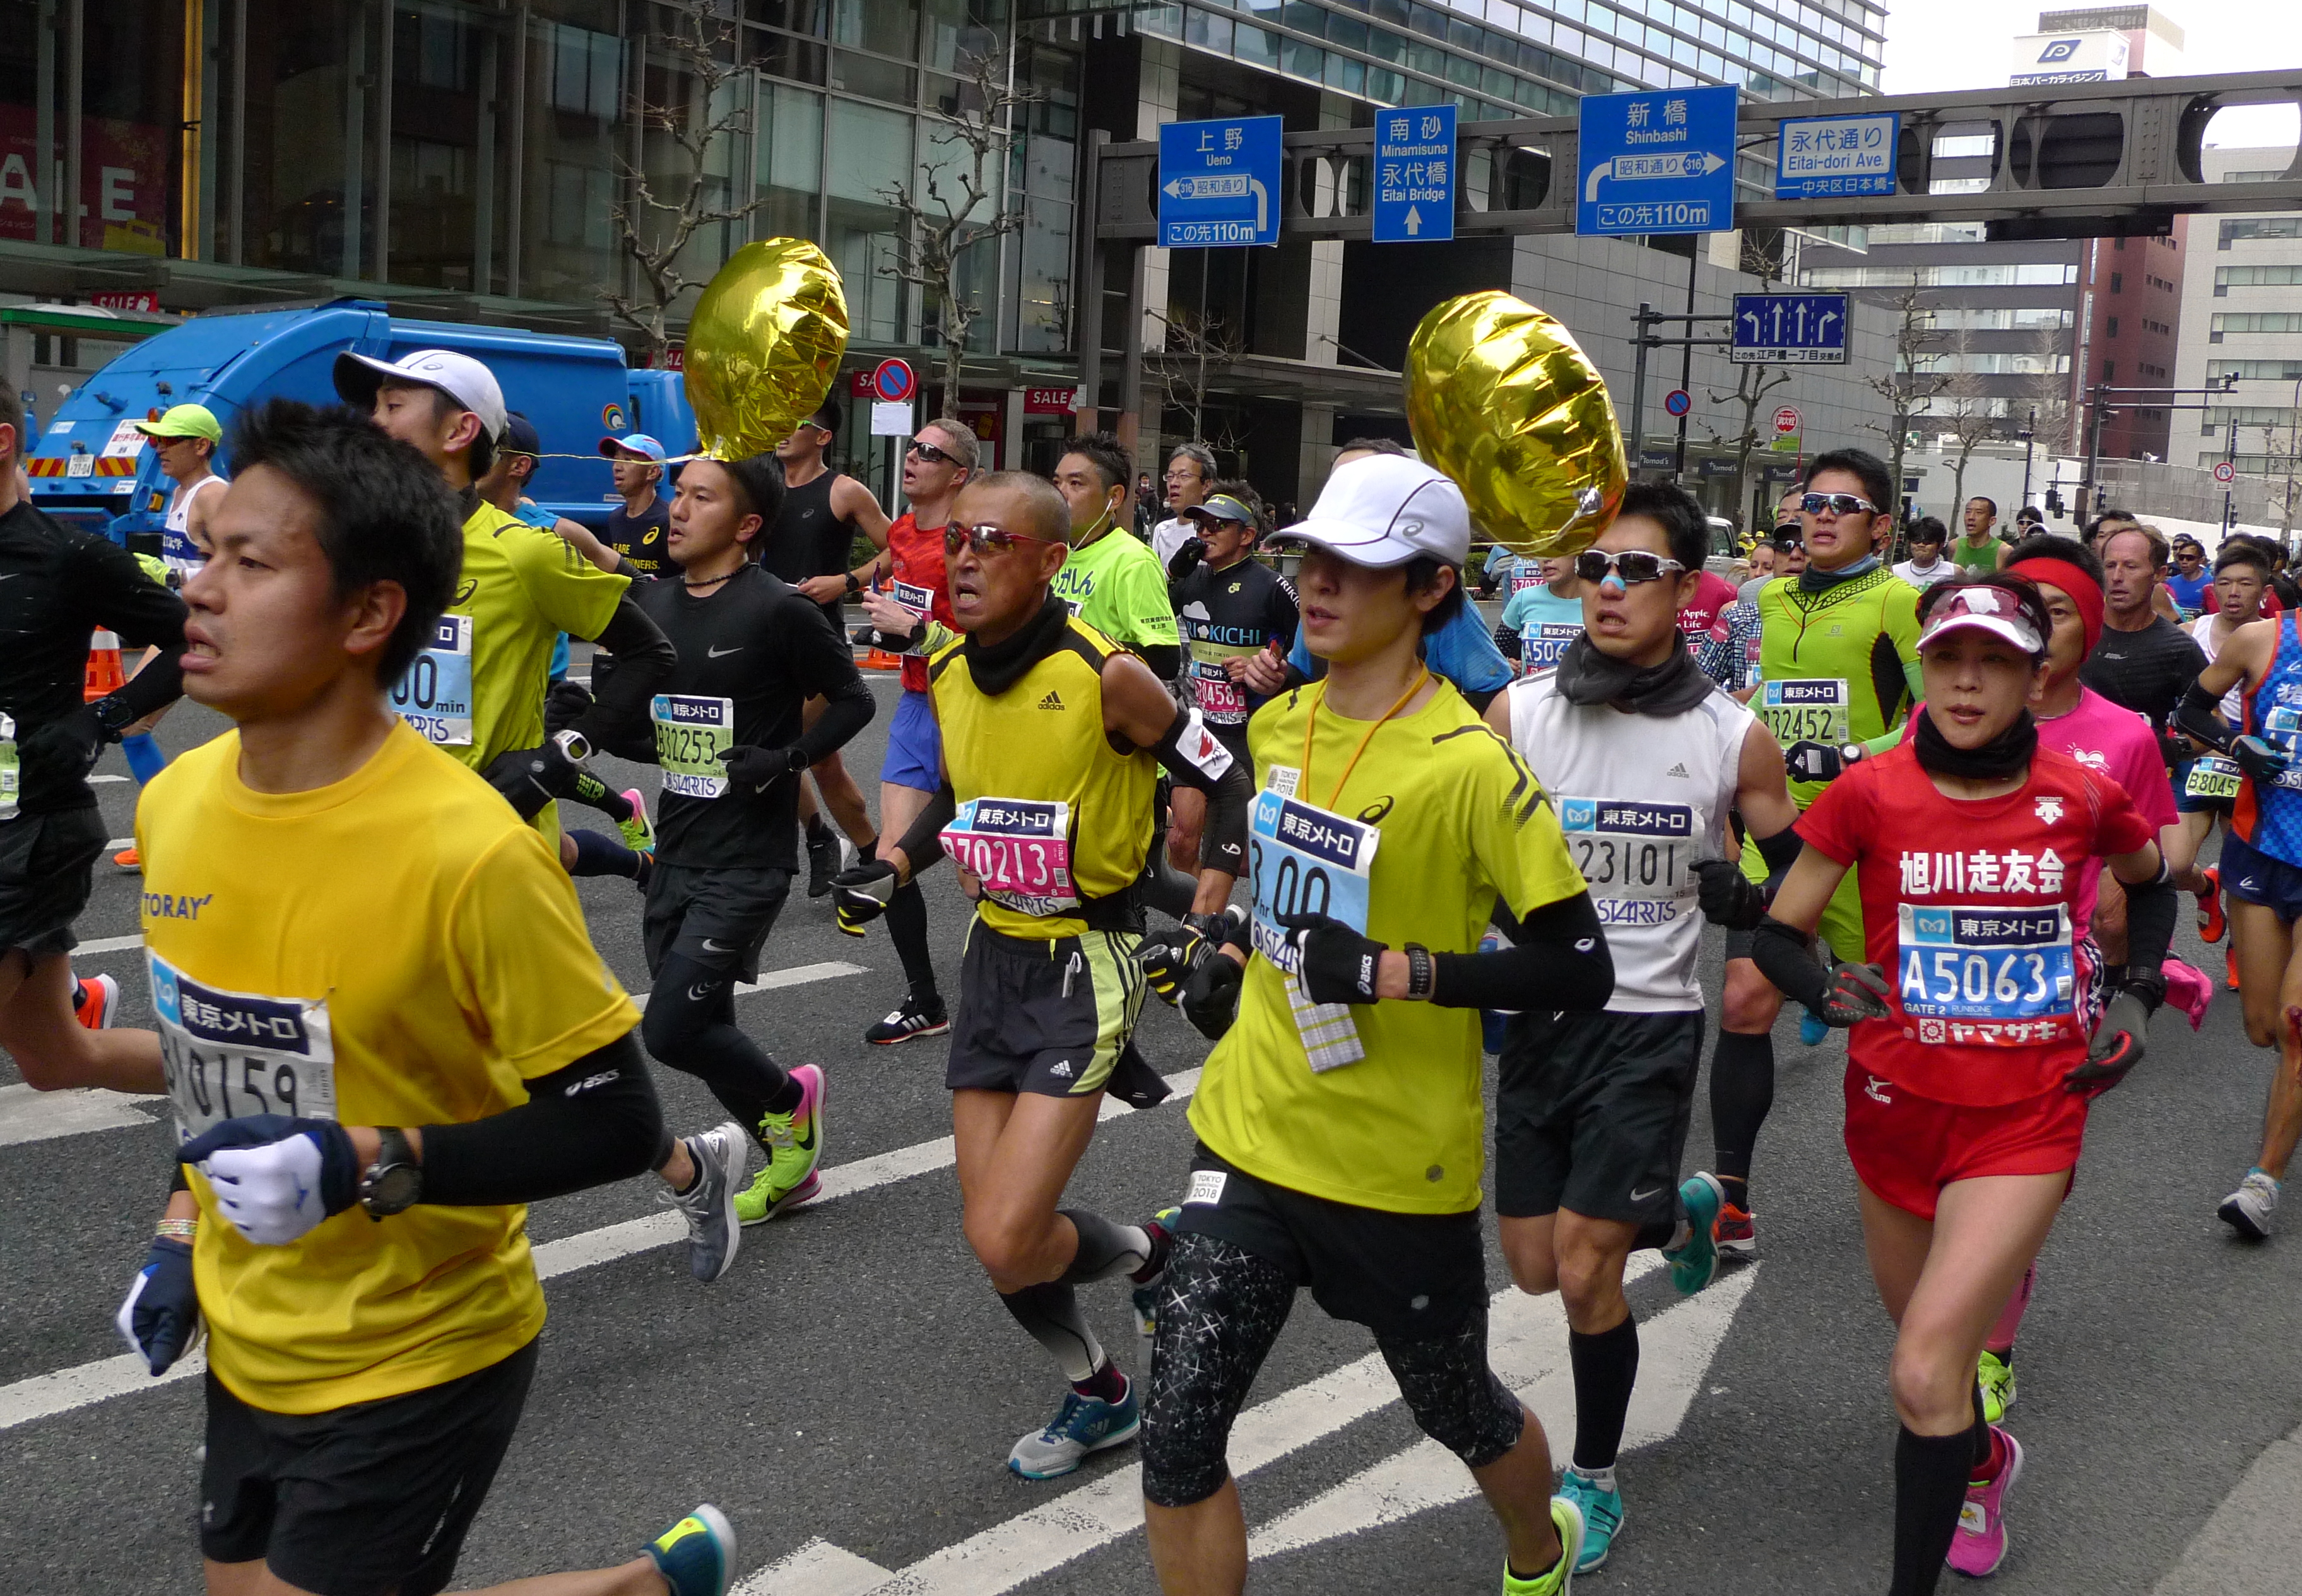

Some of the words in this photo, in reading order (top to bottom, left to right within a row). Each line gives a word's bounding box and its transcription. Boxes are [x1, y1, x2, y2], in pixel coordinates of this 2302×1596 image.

[2010, 73, 2104, 86] 日本パーカライジング
[1626, 99, 1687, 127] 新橋
[1390, 115, 1442, 141] 南砂
[1626, 127, 1687, 145] Shinbashi
[1196, 127, 1242, 151] 上野
[1791, 127, 1882, 152] 永代通り
[1381, 143, 1448, 157] Minamisuna
[1207, 154, 1232, 166] Ueno
[1620, 158, 1678, 175] 昭和通り
[1685, 159, 1702, 170] 316
[1788, 153, 1851, 170] Eitai-dori
[1856, 153, 1884, 167] Ave.
[1382, 161, 1447, 187] 永代橋
[1180, 183, 1193, 194] 316
[1198, 179, 1243, 194] 昭和通り
[1802, 177, 1887, 194] 中央区日本橋
[1382, 188, 1406, 202] Eitai
[1410, 187, 1446, 203] Bridge
[1033, 391, 1068, 404] SALE
[1209, 624, 1260, 644] KICHI
[1525, 641, 1571, 663] A506
[1201, 666, 1224, 678] 東京メト
[1785, 687, 1834, 699] 東京メトロ
[436, 700, 466, 713] min
[673, 704, 719, 718] 東京メトロ
[1277, 783, 1294, 796] 2018
[2188, 772, 2241, 796] B8045
[977, 808, 1049, 827] 東京メトロ
[1602, 810, 1685, 829] 東京メトロ
[1282, 812, 1355, 856] 東京メトロ
[1566, 837, 1674, 887] 23101
[1899, 848, 2066, 896] 旭川走友会
[1260, 899, 1270, 917] hr
[1960, 919, 2054, 937] 東京メトロ
[1361, 954, 1372, 983] asics
[1902, 950, 2047, 1003] A5063
[181, 993, 300, 1039] 東京メトロ
[1904, 1003, 1936, 1015] GATE
[1939, 1005, 1946, 1015] 2
[1949, 1021, 2057, 1043] ヤマザキ
[1198, 1175, 1222, 1183] TOKYO
[1193, 1188, 1217, 1198] 2018
